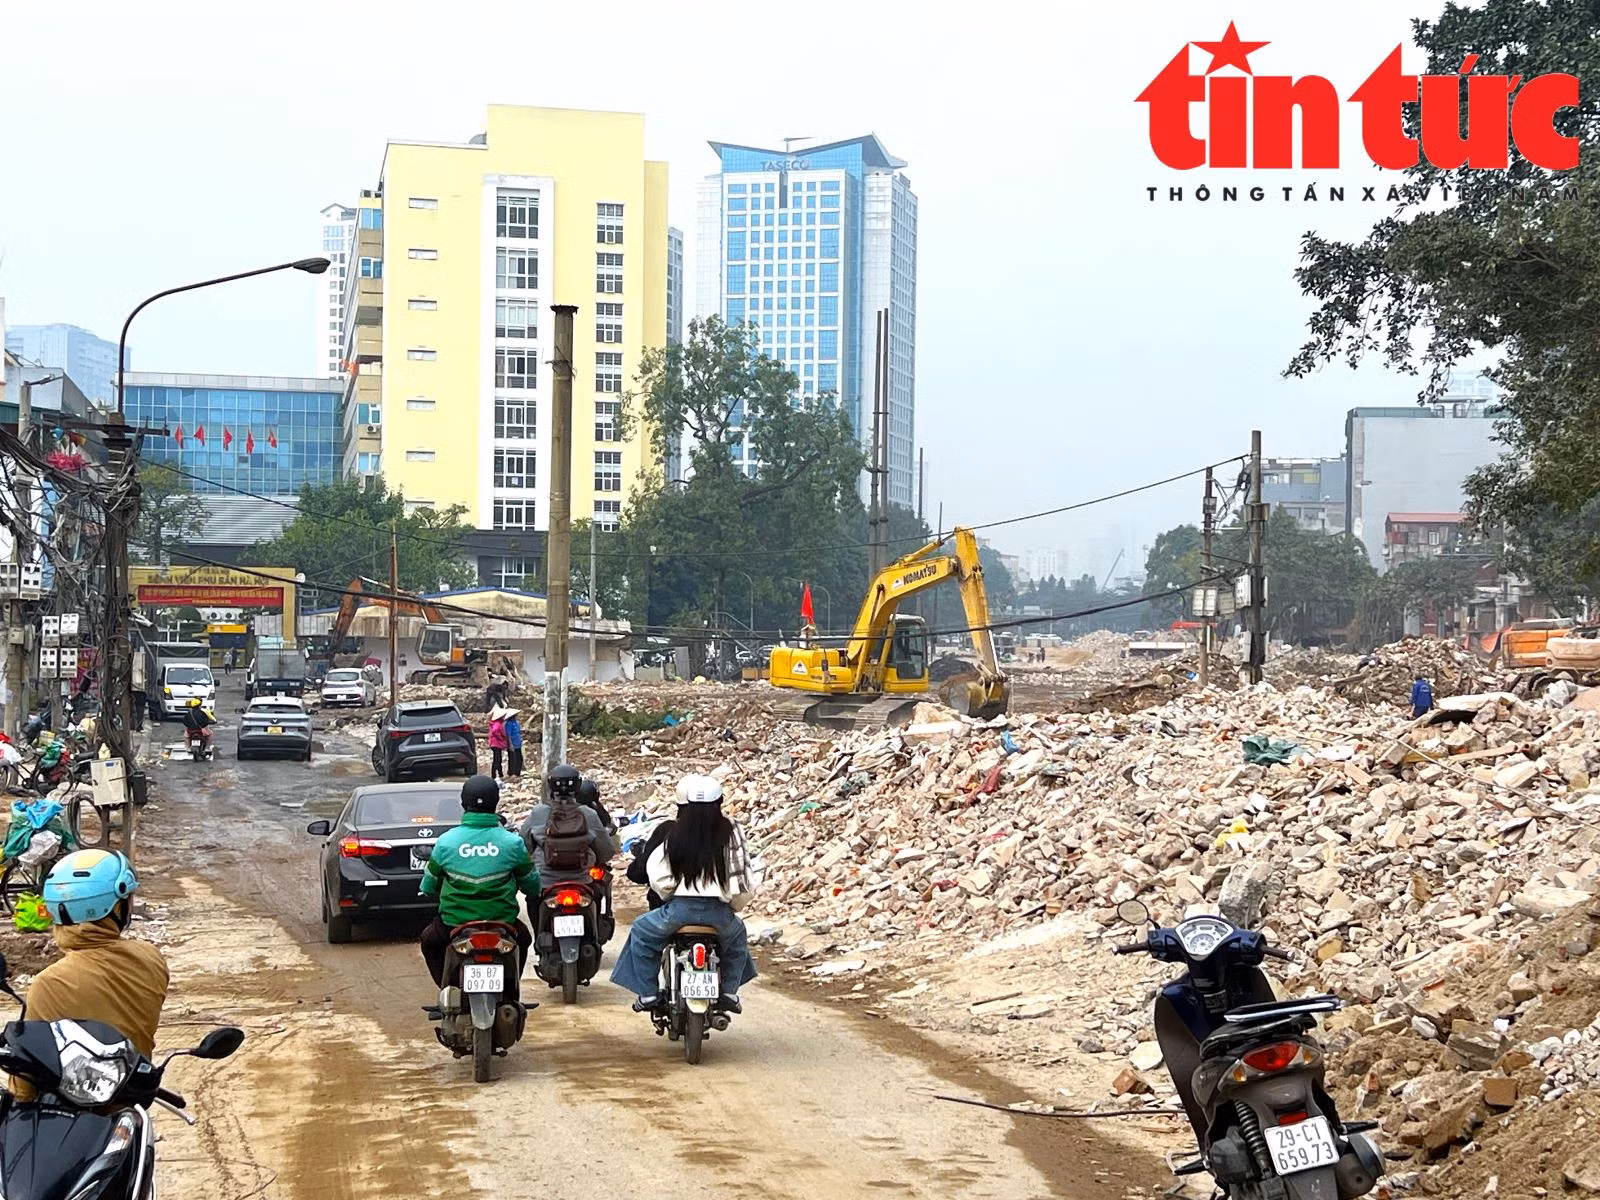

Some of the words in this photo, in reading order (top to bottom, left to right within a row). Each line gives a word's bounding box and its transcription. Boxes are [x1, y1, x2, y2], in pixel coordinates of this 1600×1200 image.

[760, 160, 810, 172] TASECO
[903, 564, 937, 585] KOMATSU
[458, 842, 500, 858] Grab
[1276, 1123, 1321, 1148] 29-C1
[1278, 1141, 1334, 1170] 659.73
